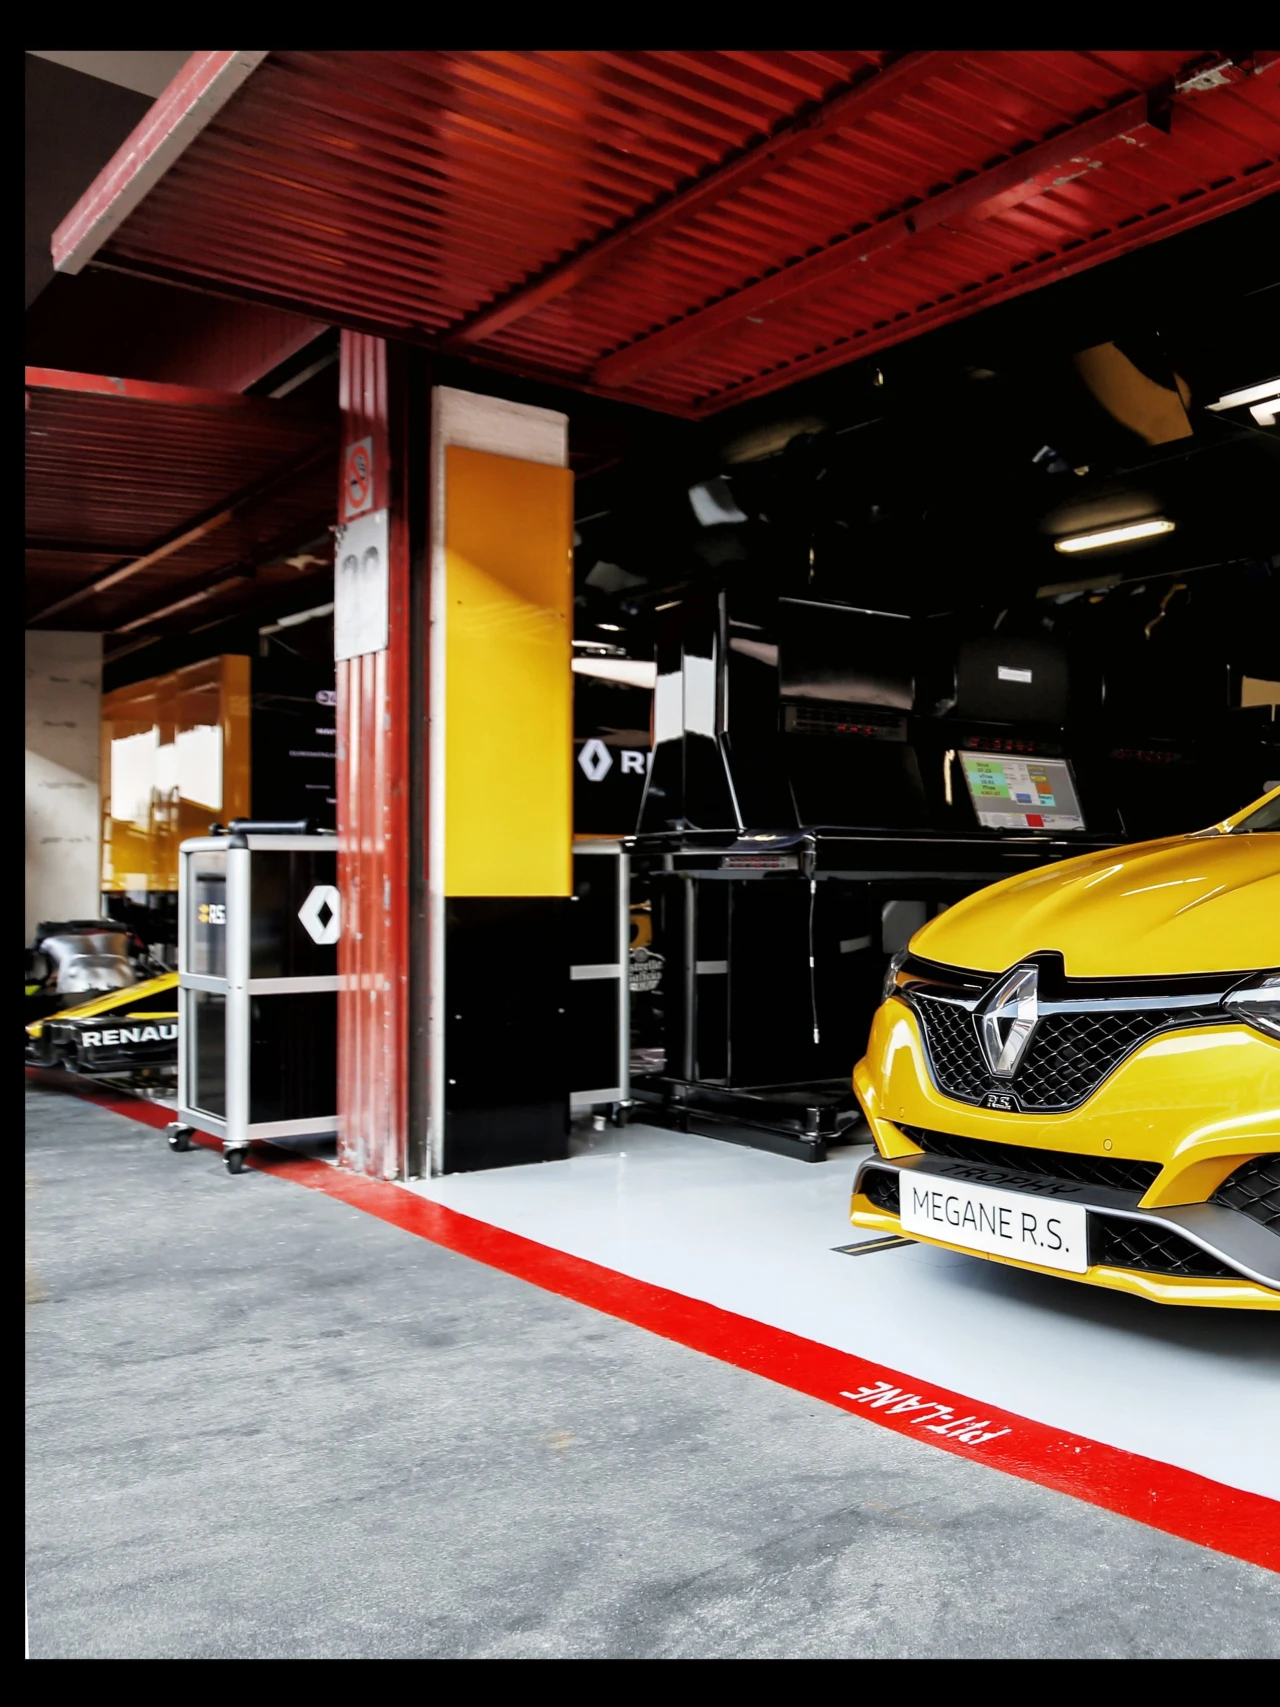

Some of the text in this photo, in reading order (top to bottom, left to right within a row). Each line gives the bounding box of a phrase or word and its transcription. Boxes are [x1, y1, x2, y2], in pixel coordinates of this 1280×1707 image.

[940, 1164, 1082, 1195] TROPHY
[913, 1187, 1070, 1253] MEGANE R.S.
